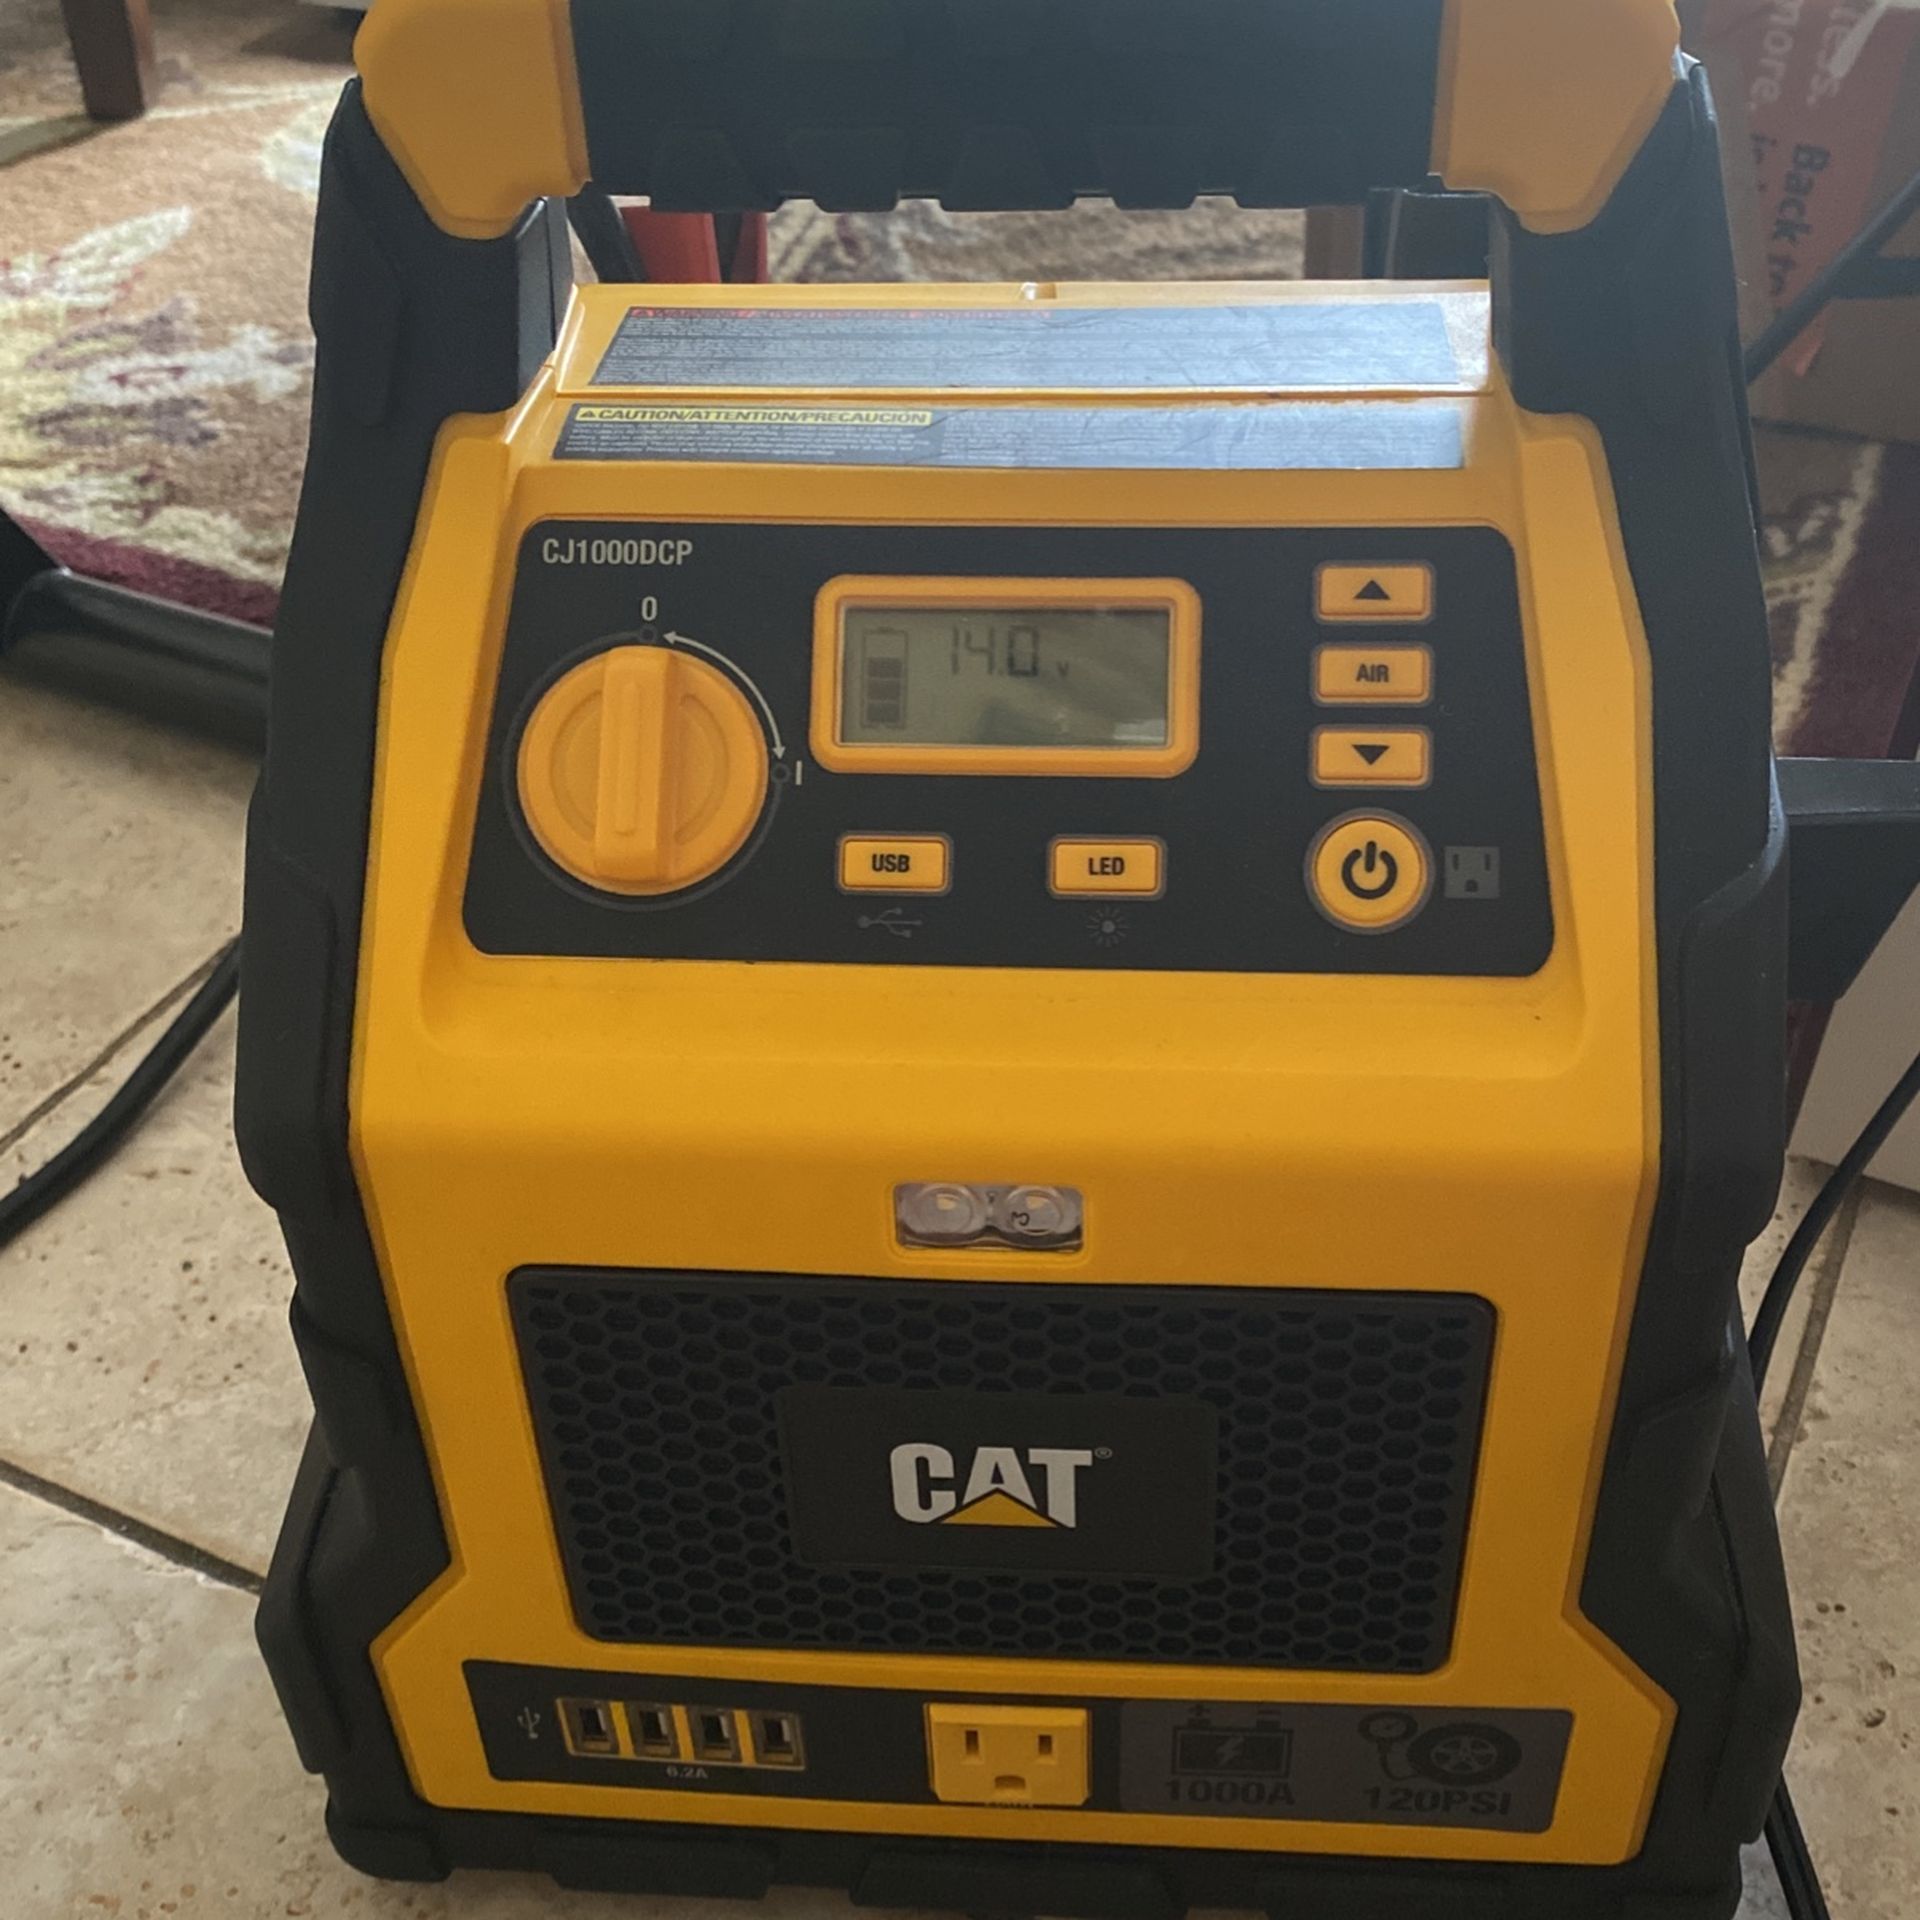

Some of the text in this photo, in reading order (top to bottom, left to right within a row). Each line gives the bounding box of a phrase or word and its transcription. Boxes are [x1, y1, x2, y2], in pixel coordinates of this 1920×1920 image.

[1772, 144, 1832, 245] Back
[543, 538, 693, 566] CJ1000DCP
[1355, 664, 1390, 683] AIR
[871, 854, 910, 873] USB
[1088, 857, 1125, 877] LED
[890, 1443, 1093, 1528] CAT
[1166, 1779, 1296, 1806] 1000A
[1362, 1786, 1512, 1816] 120PSI
